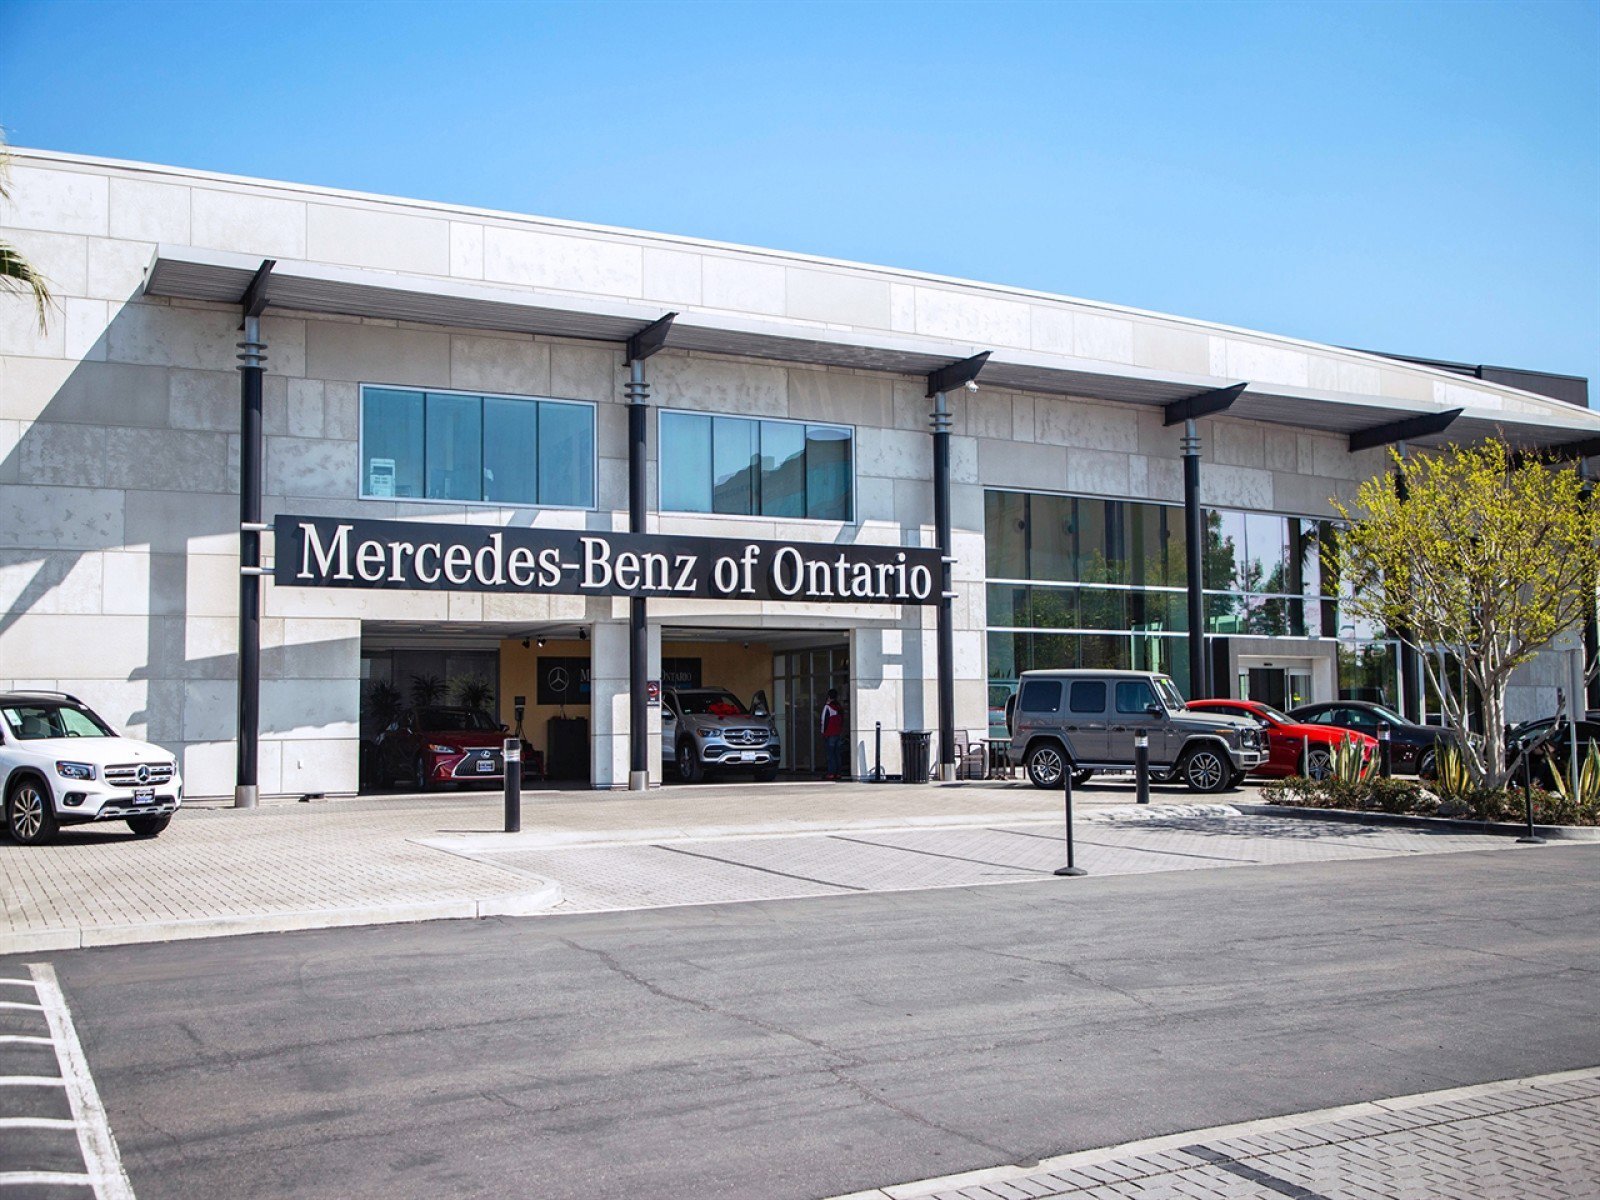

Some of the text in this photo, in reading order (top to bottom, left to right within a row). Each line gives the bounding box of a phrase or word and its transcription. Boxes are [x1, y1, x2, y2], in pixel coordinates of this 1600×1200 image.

[297, 523, 932, 600] Mercedes-Benz of Ontario
